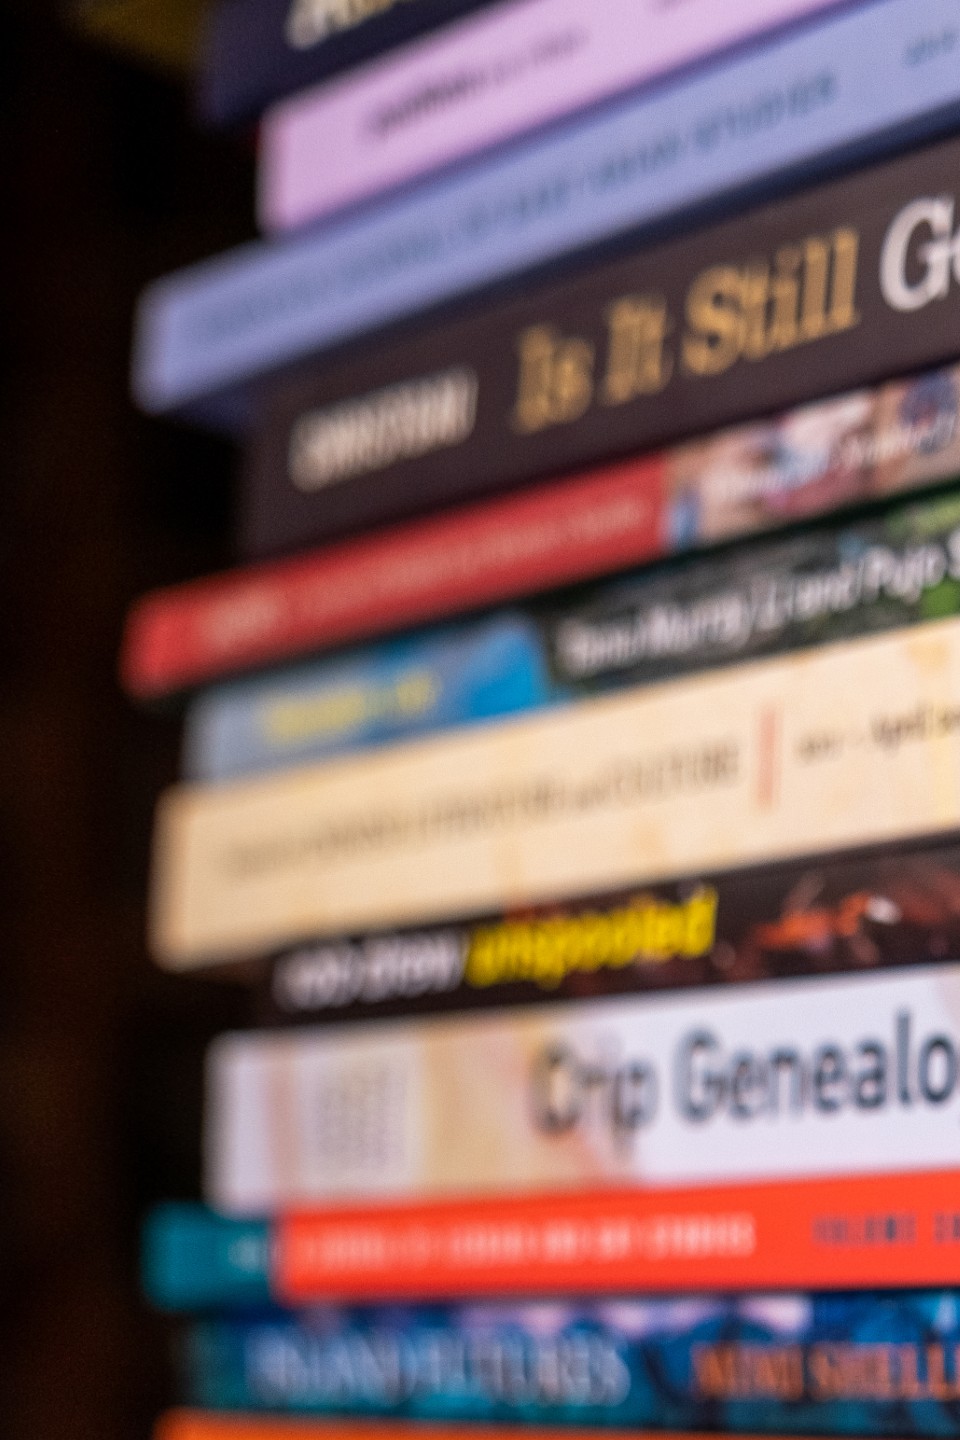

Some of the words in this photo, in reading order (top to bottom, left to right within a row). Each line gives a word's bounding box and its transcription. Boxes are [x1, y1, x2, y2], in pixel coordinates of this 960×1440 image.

[513, 322, 594, 434] Is
[605, 295, 672, 404] It
[682, 228, 859, 375] Still
[528, 1030, 657, 1162] Crip
